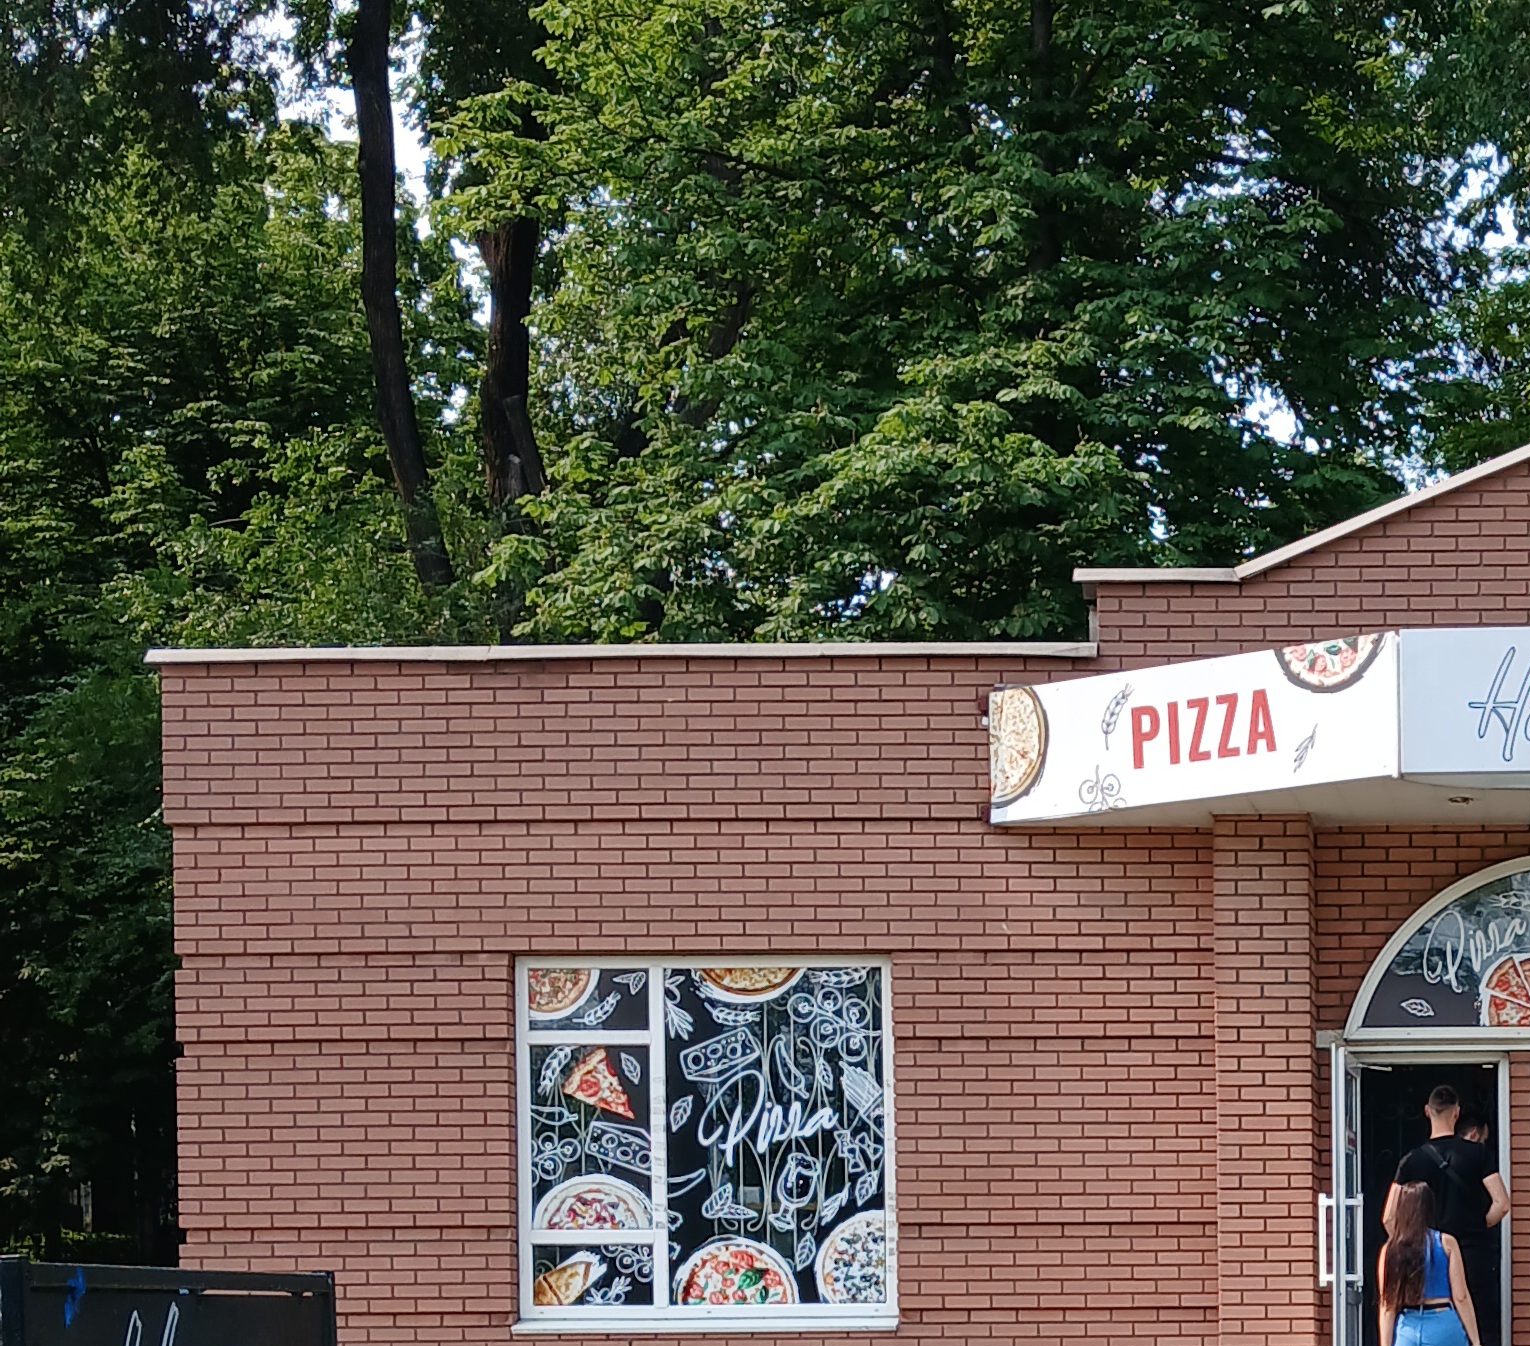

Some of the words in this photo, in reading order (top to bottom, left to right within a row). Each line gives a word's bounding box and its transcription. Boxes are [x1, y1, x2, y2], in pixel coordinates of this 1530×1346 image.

[1130, 688, 1278, 770] PIZZA
[1421, 909, 1528, 993] Pizza
[697, 1069, 840, 1167] Pizza
